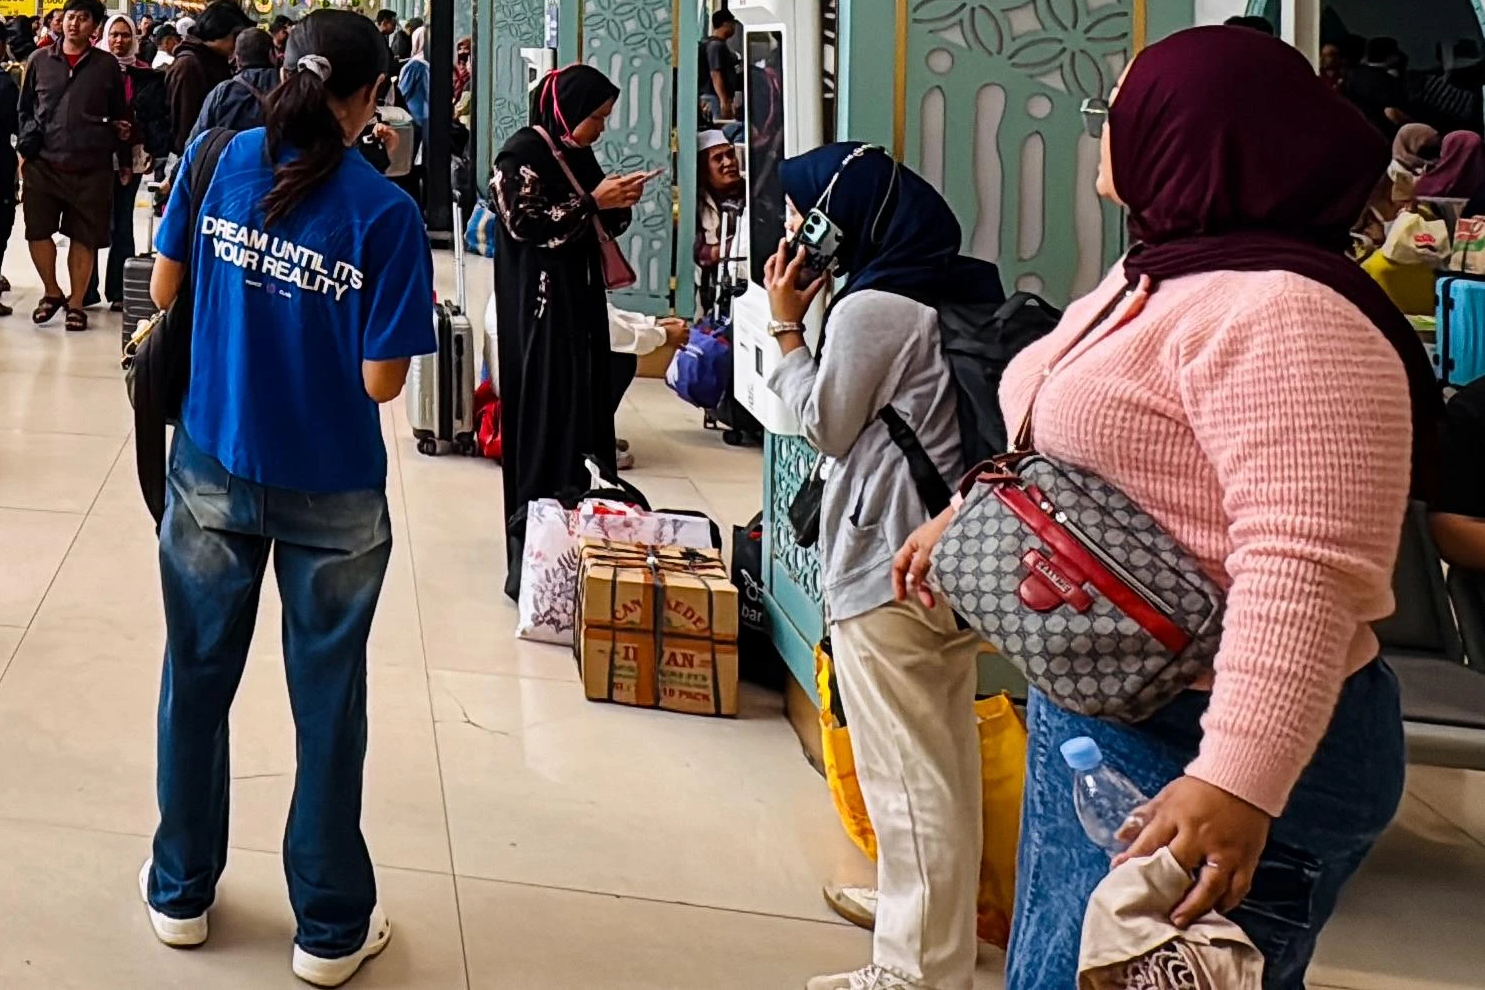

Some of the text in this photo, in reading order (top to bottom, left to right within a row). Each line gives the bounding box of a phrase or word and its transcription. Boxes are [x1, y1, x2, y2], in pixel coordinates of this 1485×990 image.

[201, 215, 364, 290] DREAM UNTIL ITS
[212, 237, 349, 302] YOUR REALITY
